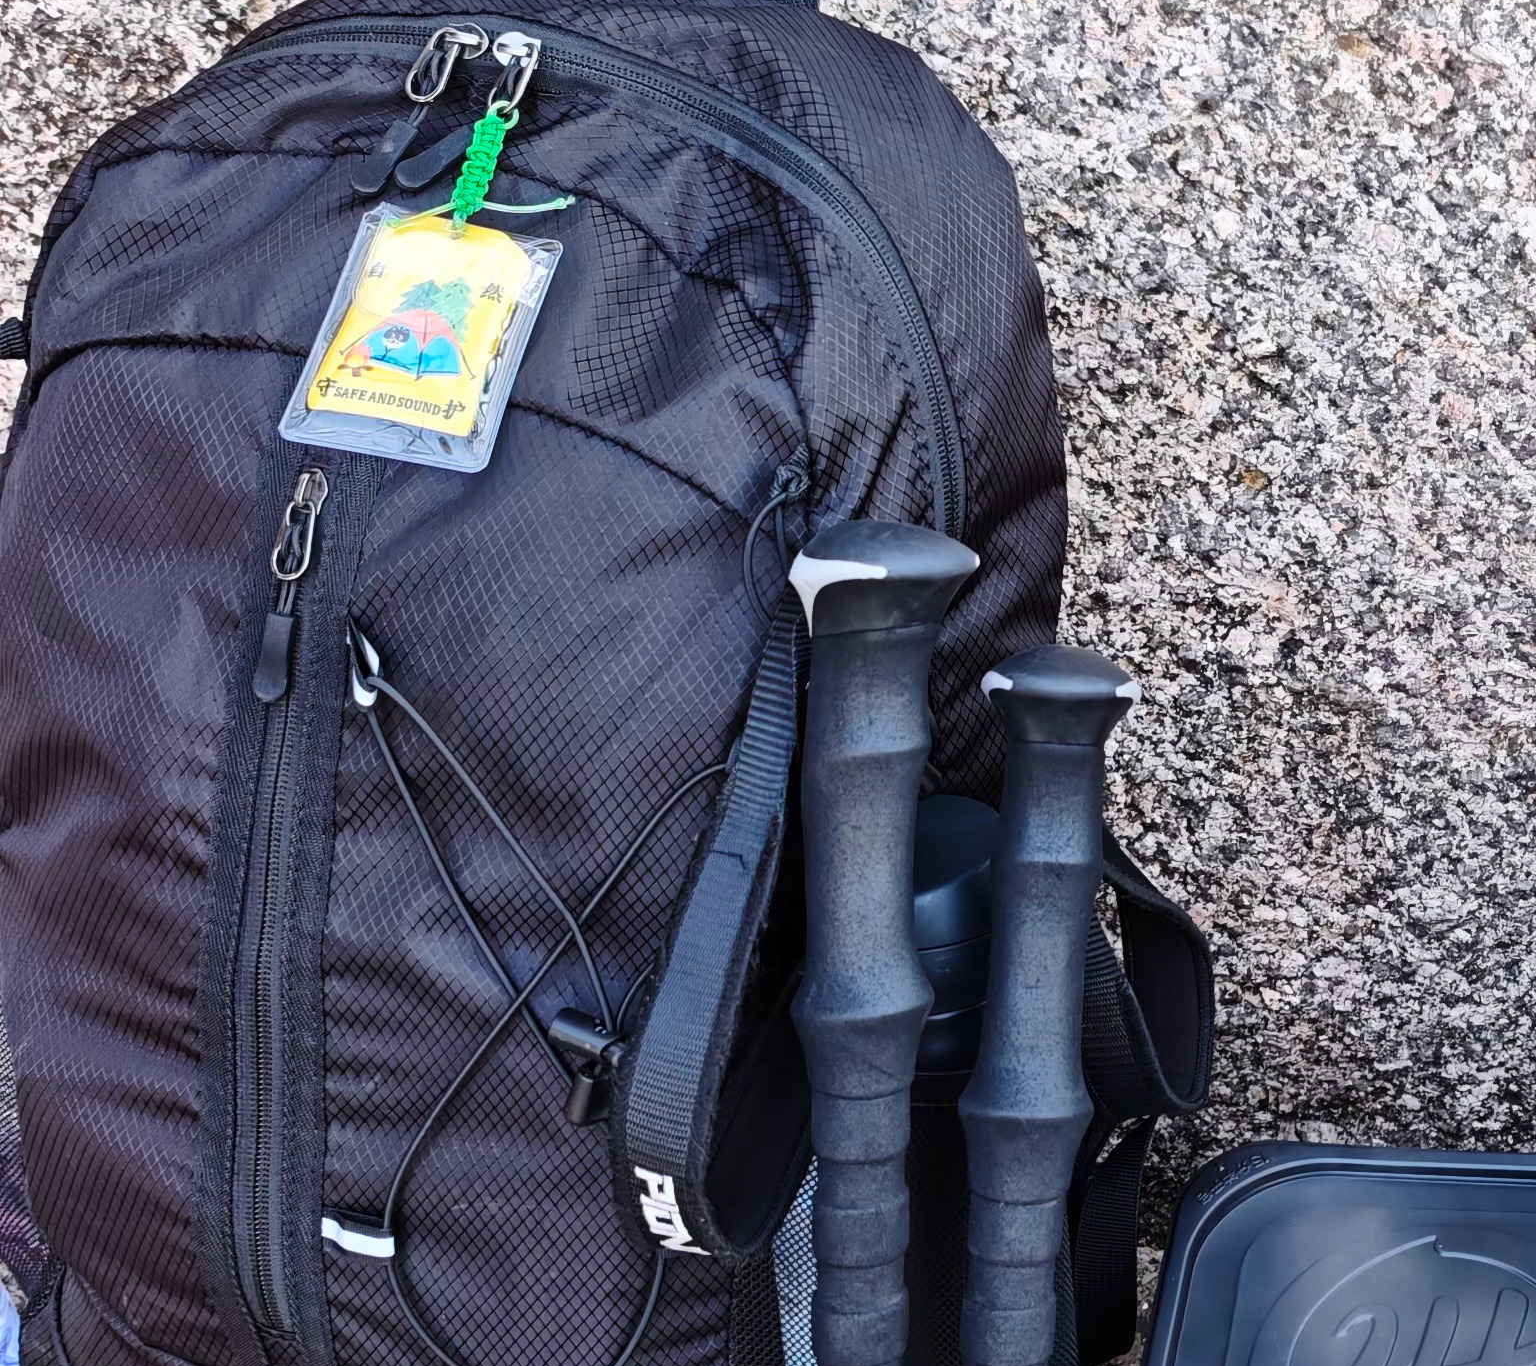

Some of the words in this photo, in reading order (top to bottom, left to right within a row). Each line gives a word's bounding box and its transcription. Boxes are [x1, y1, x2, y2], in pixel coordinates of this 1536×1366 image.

[368, 261, 386, 278] 自
[479, 282, 505, 303] 然
[316, 377, 338, 398] 守
[334, 386, 369, 403] SAFE
[367, 392, 396, 406] AND
[395, 397, 442, 417] SOUND
